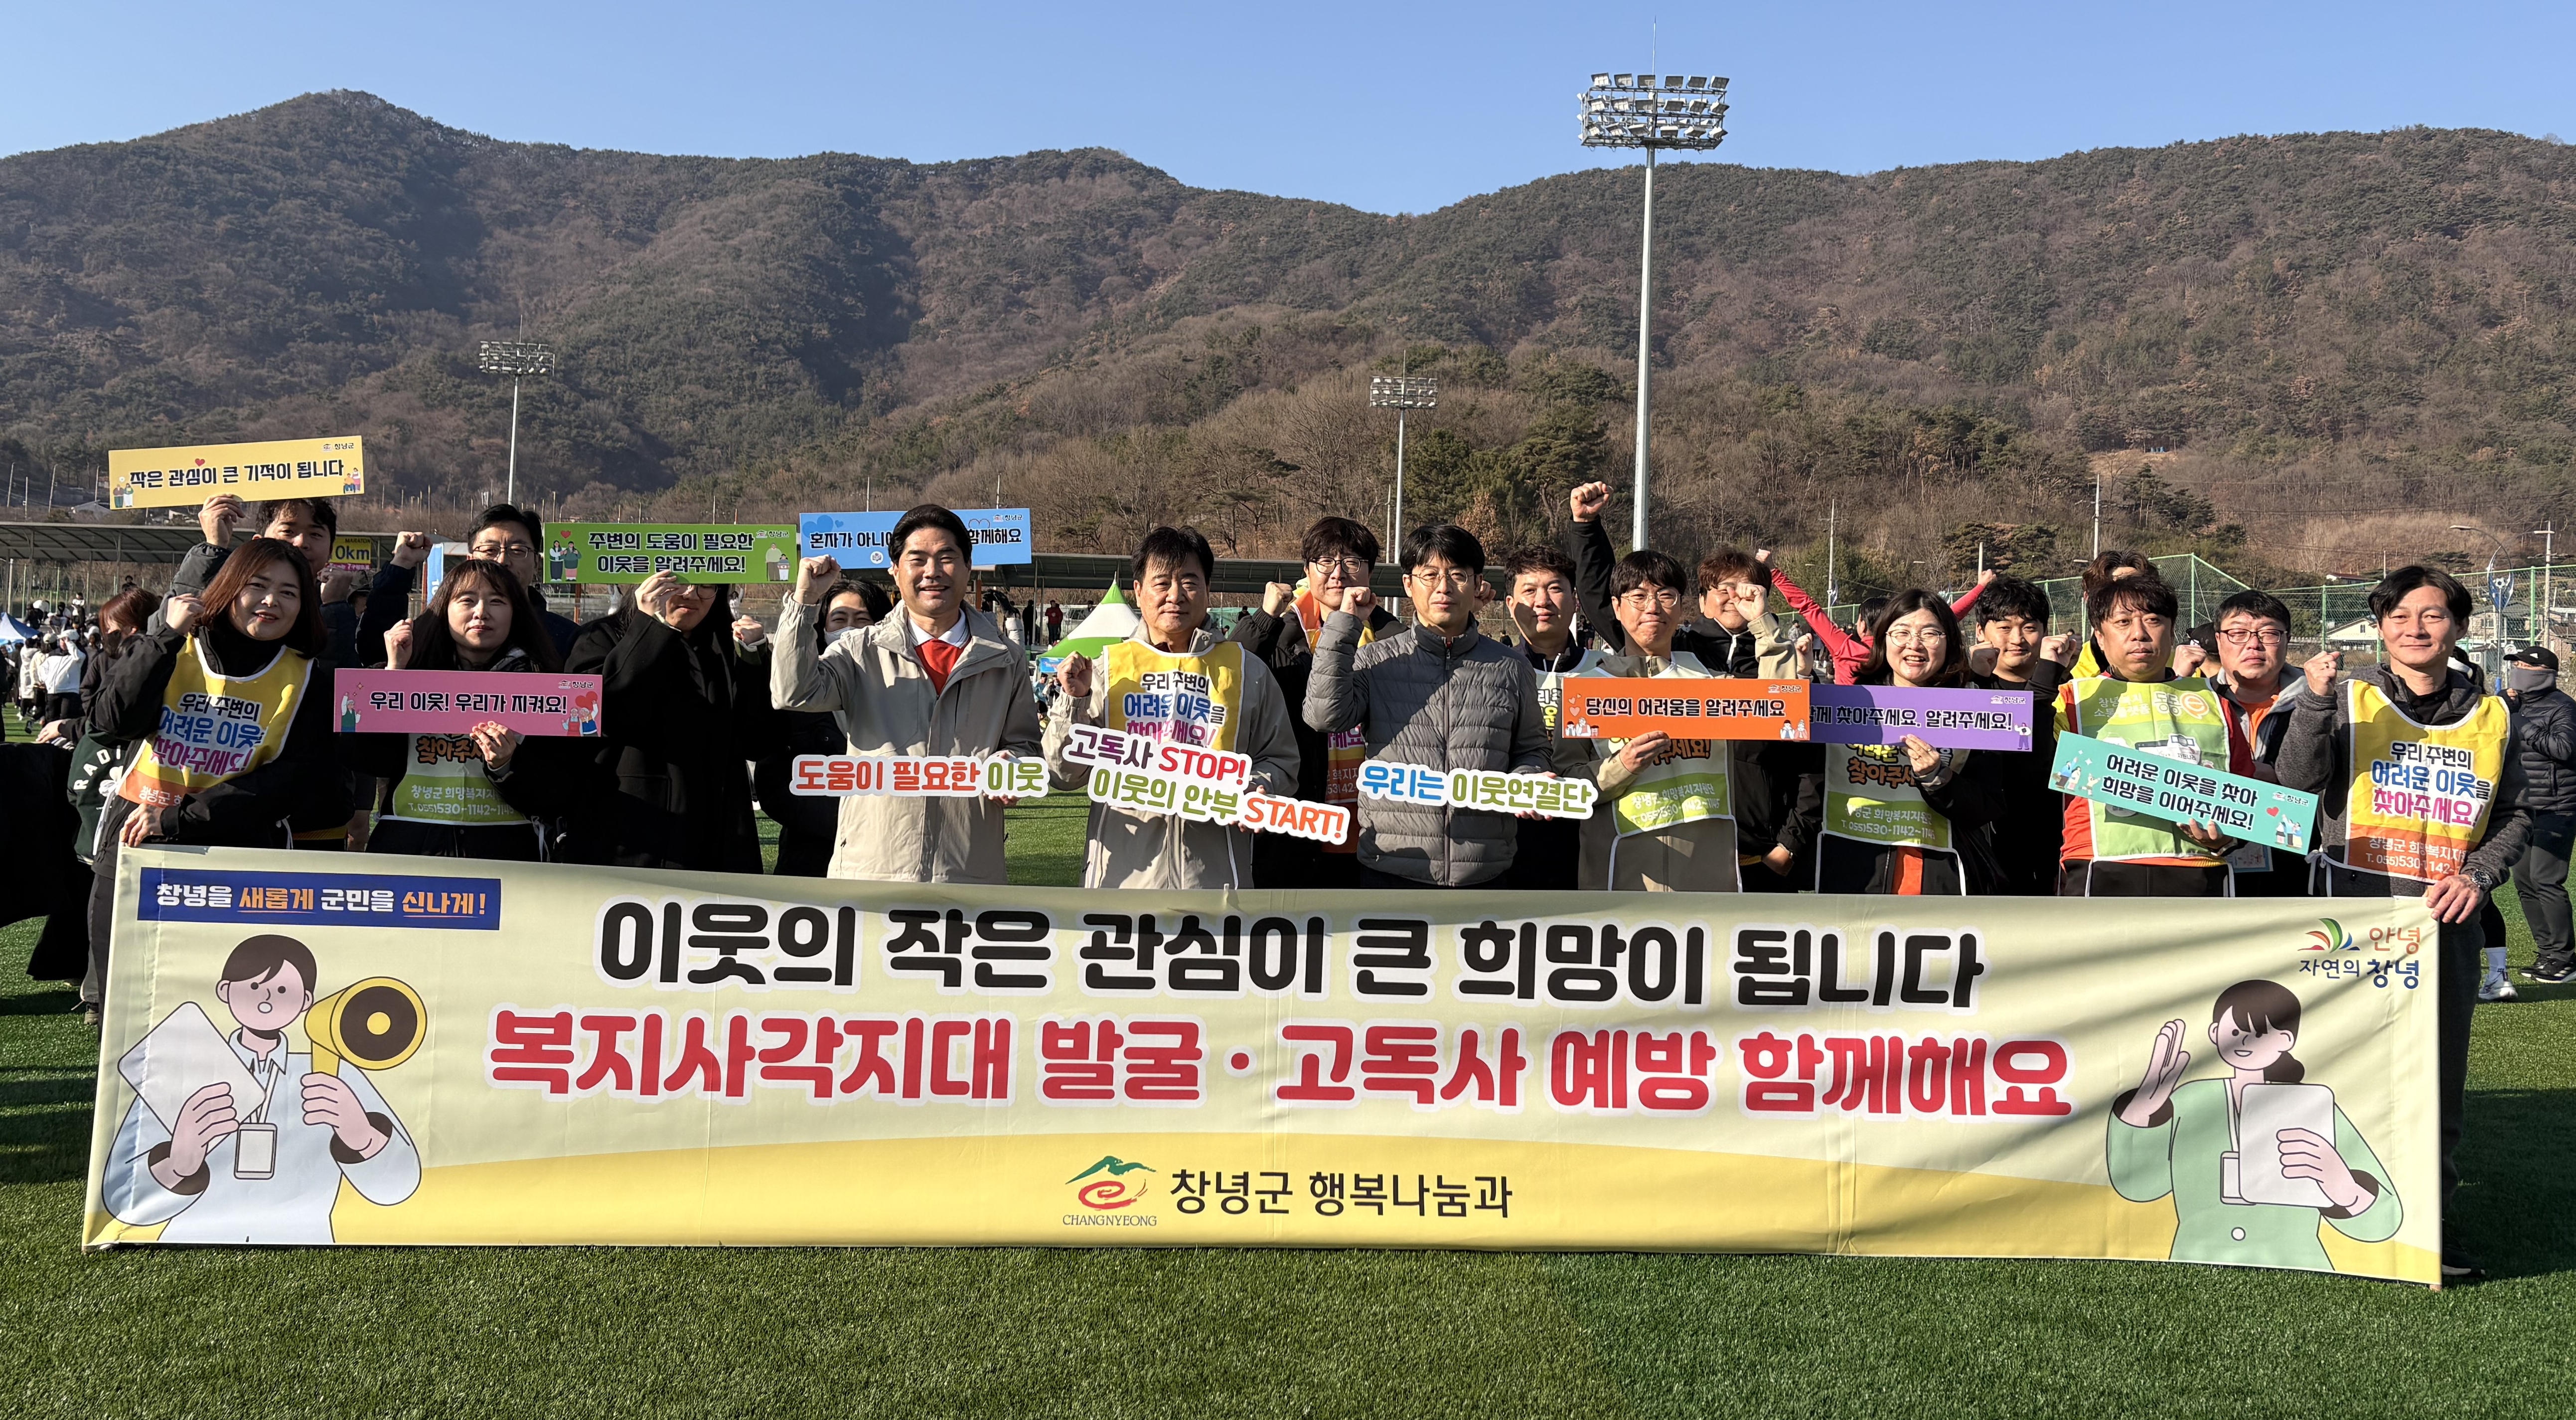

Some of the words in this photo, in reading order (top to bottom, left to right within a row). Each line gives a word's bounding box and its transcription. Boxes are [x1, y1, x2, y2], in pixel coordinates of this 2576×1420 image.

[130, 470, 163, 488] 작은
[168, 467, 217, 487] 관심이
[223, 465, 239, 483] 큰
[244, 462, 291, 482] 기적이
[297, 459, 344, 479] 됩니다
[589, 533, 640, 550] 주변의
[646, 533, 698, 551] 도움이
[703, 533, 754, 551] 필요한
[810, 533, 853, 549] 혼자가
[598, 556, 649, 572] 이웃을
[655, 556, 746, 573] 알려주세요!
[1142, 673, 1169, 691] 우리
[1173, 672, 1210, 696] 주변의
[180, 694, 212, 713] 우리
[213, 697, 260, 721] 주변의
[370, 692, 404, 710] 우리
[411, 693, 449, 712] 이웃!
[455, 694, 506, 713] 우리가
[510, 695, 567, 714] 지켜요!
[1124, 693, 1173, 717] 어려운
[1586, 698, 1632, 716] 당신의
[1638, 698, 1700, 716] 어려움을
[1705, 699, 1786, 717] 알려주세요
[159, 707, 213, 743] 어려운
[1836, 706, 1921, 727] 찾아주세요.
[1925, 710, 2012, 731] 알려주세요!
[1068, 730, 1153, 769] 고독사
[1159, 747, 1246, 785] STOP!
[2391, 742, 2422, 762] 우리
[2426, 746, 2471, 770] 주변의
[796, 761, 883, 790] 도움이
[893, 762, 980, 791] 필요한
[988, 762, 1043, 791] 이웃
[1363, 766, 1444, 800] 우리는
[1453, 775, 1592, 813] 이웃연결단
[2107, 754, 2159, 782] 어려운
[2163, 769, 2216, 798] 이웃을
[2222, 783, 2258, 807] 찾아
[2372, 761, 2429, 791] 어려운
[2436, 769, 2490, 800] 이웃을
[411, 785, 443, 799] 창녕군
[445, 787, 495, 800] 희망복지지
[1095, 768, 1175, 809] 이웃의
[1182, 785, 1238, 819] 안부
[1245, 797, 1345, 838] START!
[2102, 776, 2154, 805] 희망을
[2159, 791, 2255, 831] 이어주세요!
[2374, 788, 2484, 827] 찾아주세요!
[2366, 853, 2374, 862] T.
[156, 883, 232, 909] 창녕을
[239, 887, 314, 910] 새롭게
[321, 889, 394, 912] 군민을
[601, 902, 856, 986] 이웃의
[887, 909, 1051, 989] 작은
[1079, 914, 1325, 994] 관심이
[1353, 919, 1431, 995] 큰
[1459, 920, 1704, 1005] 희망이
[1734, 930, 1985, 1008] 됩니다
[2369, 927, 2421, 955] 안녕
[2299, 959, 2360, 979] 자연의
[2367, 959, 2420, 989] 창녕
[491, 1010, 1010, 1100] 복지사각지대
[1042, 1019, 1203, 1100] 발굴
[1276, 1024, 1526, 1106] 고독사
[1551, 1029, 1717, 1110] 예방
[1738, 1031, 2072, 1117] 함께해요
[1169, 1169, 1294, 1215] 창녕군
[1309, 1171, 1513, 1218] 행복나눔과
[1062, 1214, 1157, 1227] CHANGNYEONG
